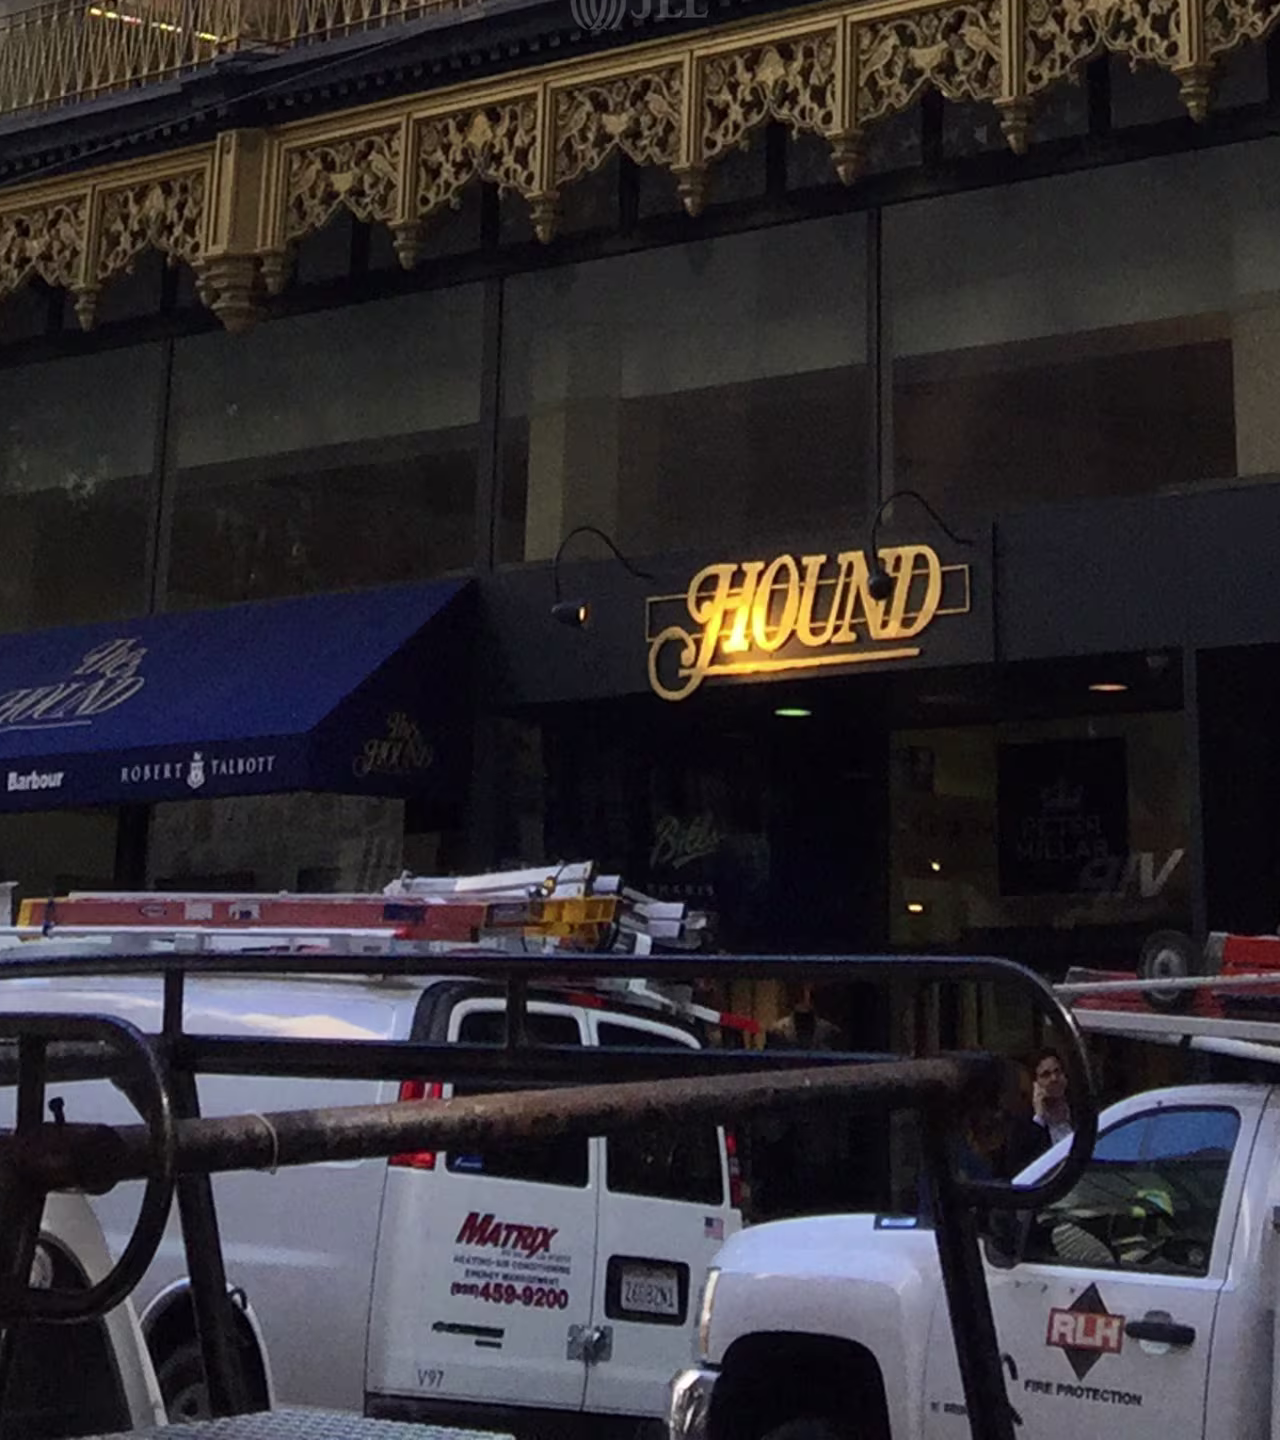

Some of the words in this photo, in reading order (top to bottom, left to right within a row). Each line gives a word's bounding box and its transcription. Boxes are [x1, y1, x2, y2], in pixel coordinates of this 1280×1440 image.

[648, 543, 943, 701] HOUND
[6, 770, 64, 793] Barbour
[120, 761, 182, 785] ROBERT
[211, 754, 277, 776] TALBOTT
[456, 1211, 558, 1259] MATRIX
[1051, 1313, 1122, 1348] RLH
[417, 1368, 445, 1388] V97
[1024, 1379, 1053, 1396] FIRE
[1056, 1383, 1142, 1406] PROTECTION
